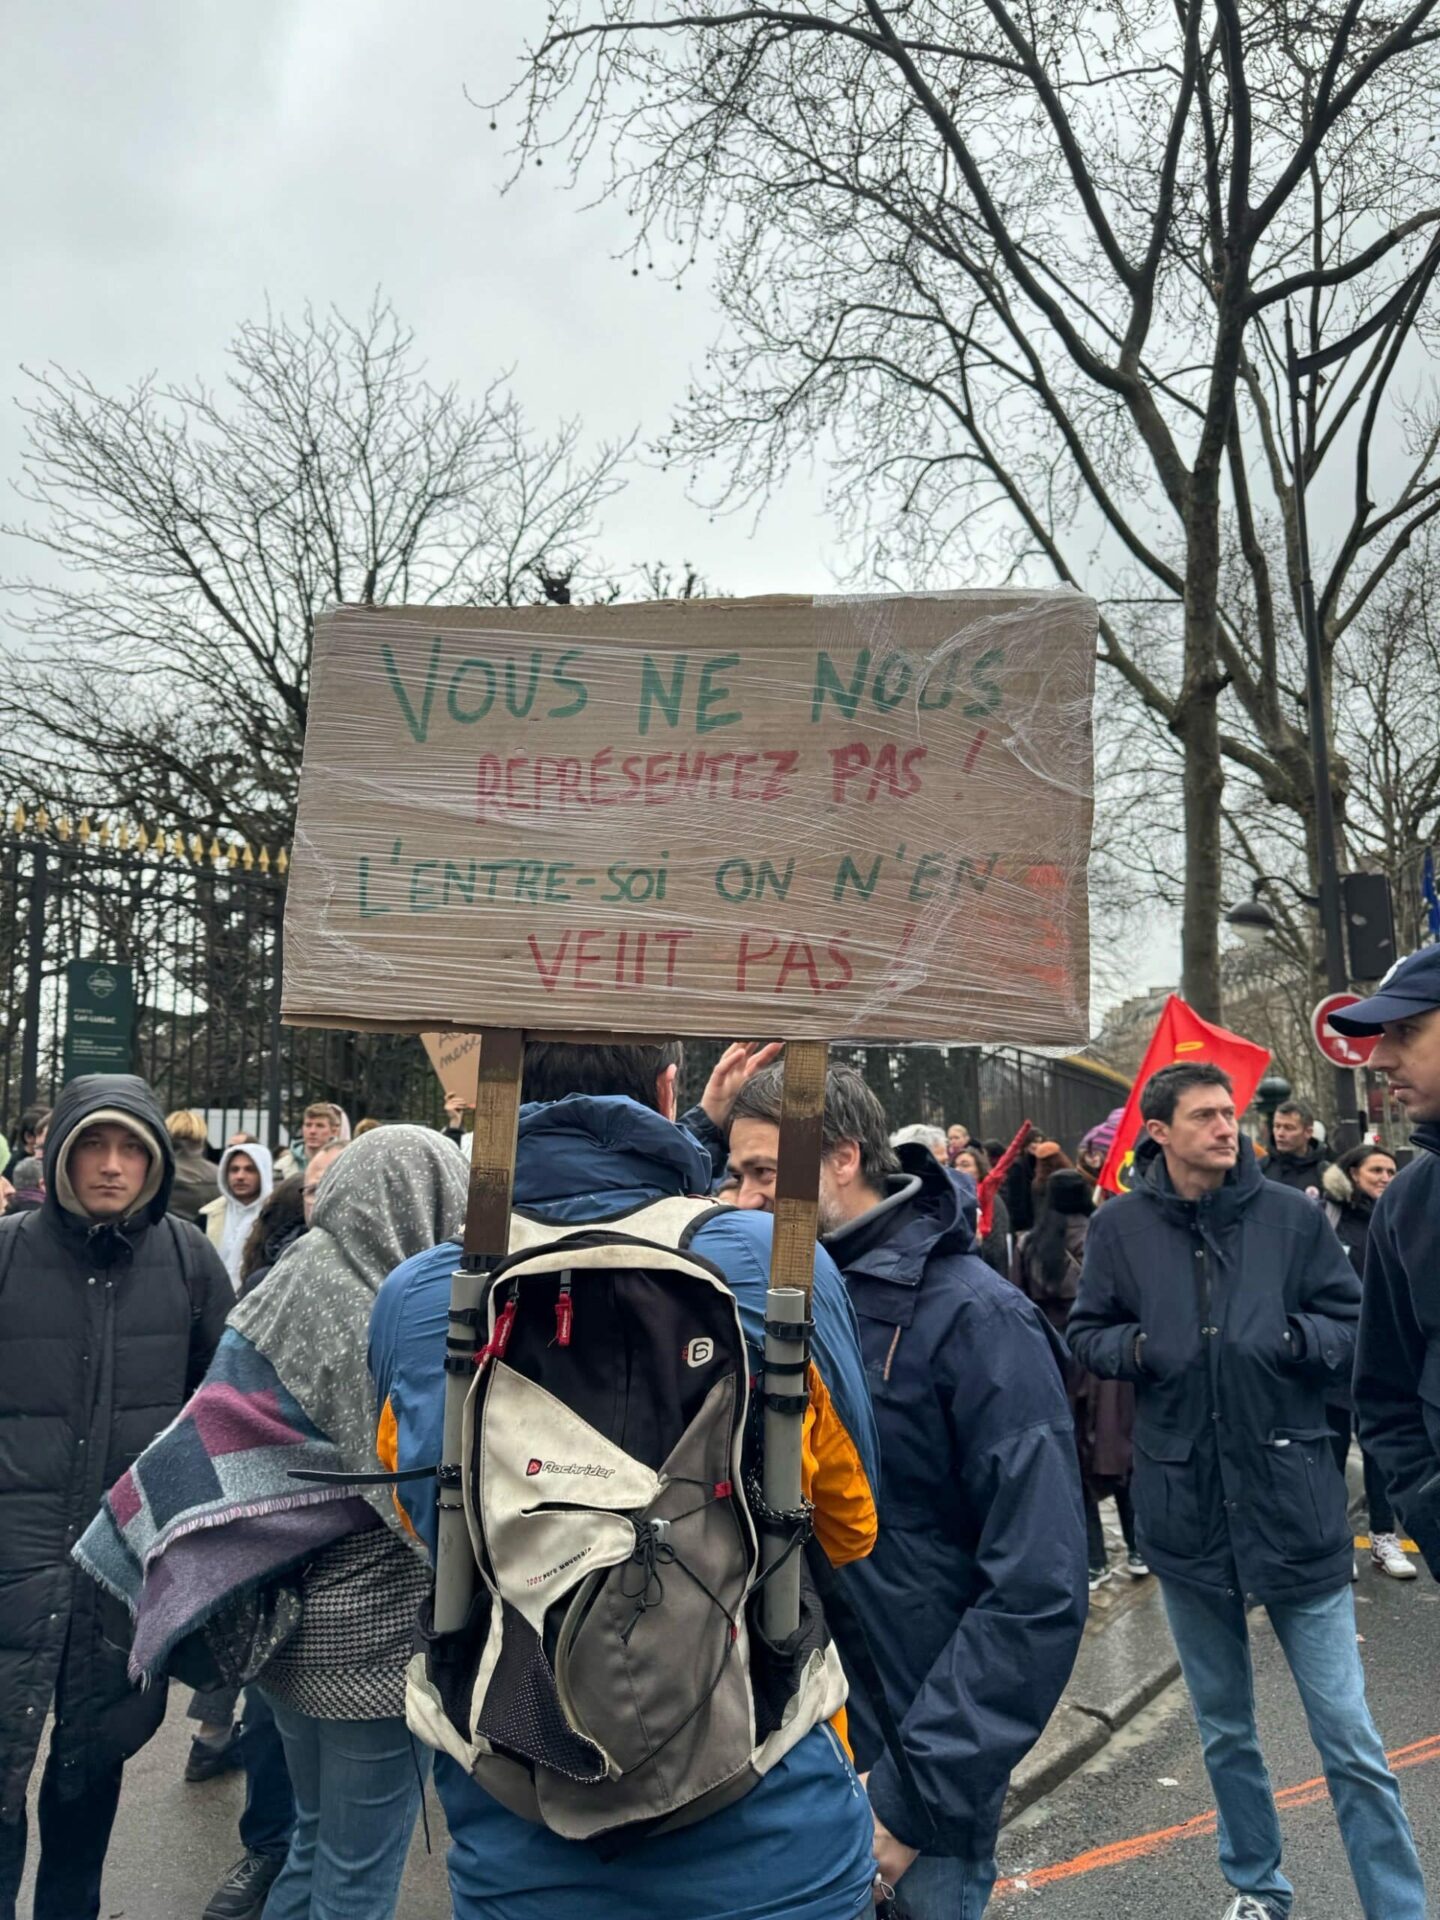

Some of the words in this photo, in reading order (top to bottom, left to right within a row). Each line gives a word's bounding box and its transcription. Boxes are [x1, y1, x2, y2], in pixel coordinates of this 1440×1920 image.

[380, 636, 588, 743] VOUS
[637, 652, 744, 736] NE
[811, 647, 1005, 723] NOUS
[475, 746, 800, 826] REPRÉSENTEZ
[828, 742, 929, 802] PAS
[714, 855, 796, 903] ON
[832, 842, 1000, 901] N'EN
[736, 927, 853, 995] PAS
[542, 1460, 616, 1479] Rockrider
